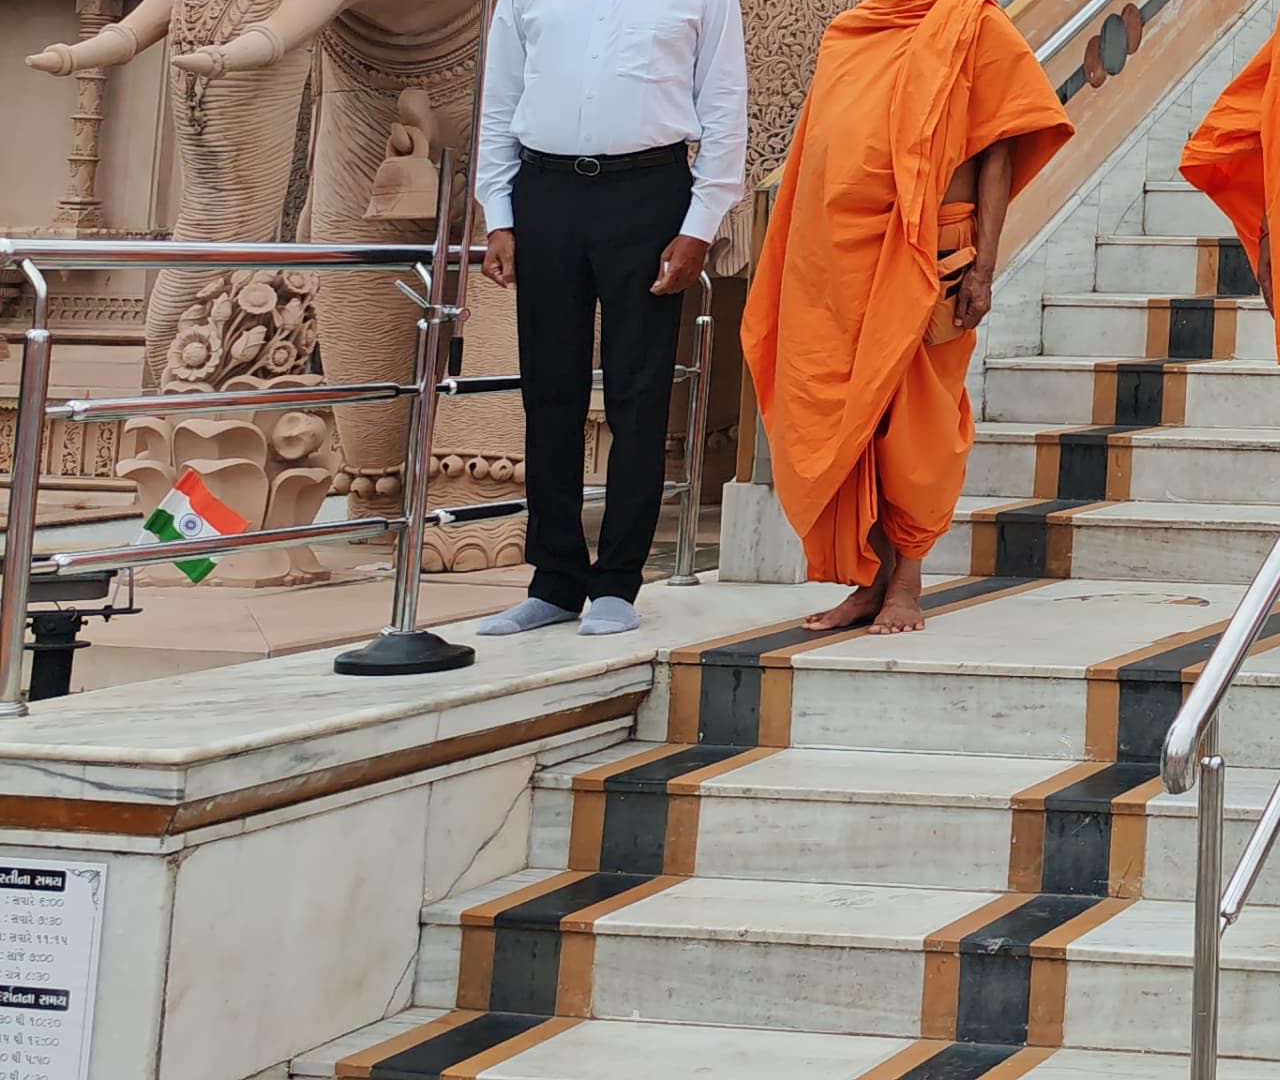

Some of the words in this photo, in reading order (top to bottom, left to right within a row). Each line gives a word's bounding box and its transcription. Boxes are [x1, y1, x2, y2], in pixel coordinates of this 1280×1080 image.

[0, 869, 31, 886] રતીના
[34, 875, 62, 888] સમય
[39, 994, 66, 1006] સમય
